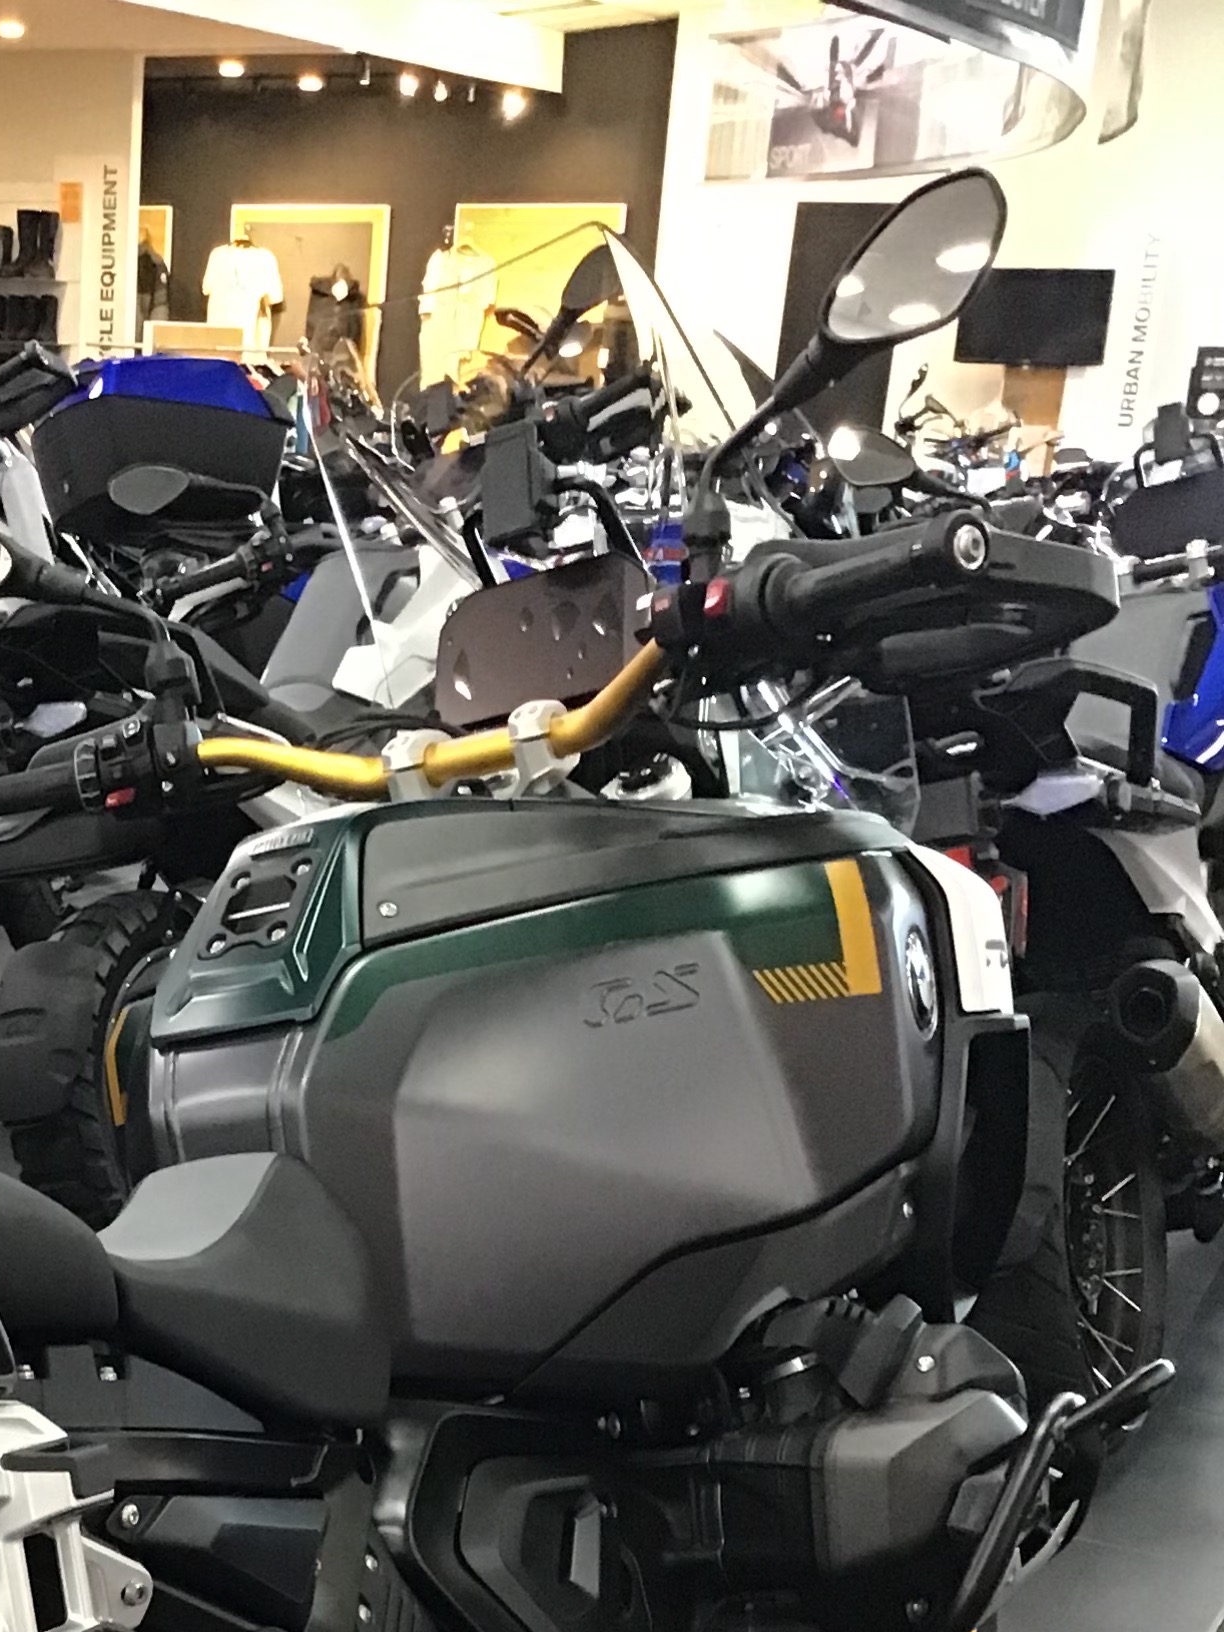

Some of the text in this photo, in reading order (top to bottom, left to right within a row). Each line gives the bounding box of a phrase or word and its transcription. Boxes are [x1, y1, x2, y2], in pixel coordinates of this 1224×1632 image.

[100, 164, 118, 302] EQUIPMENT
[1117, 233, 1161, 427] URBAN MOBILITY
[583, 962, 700, 1029] GS
